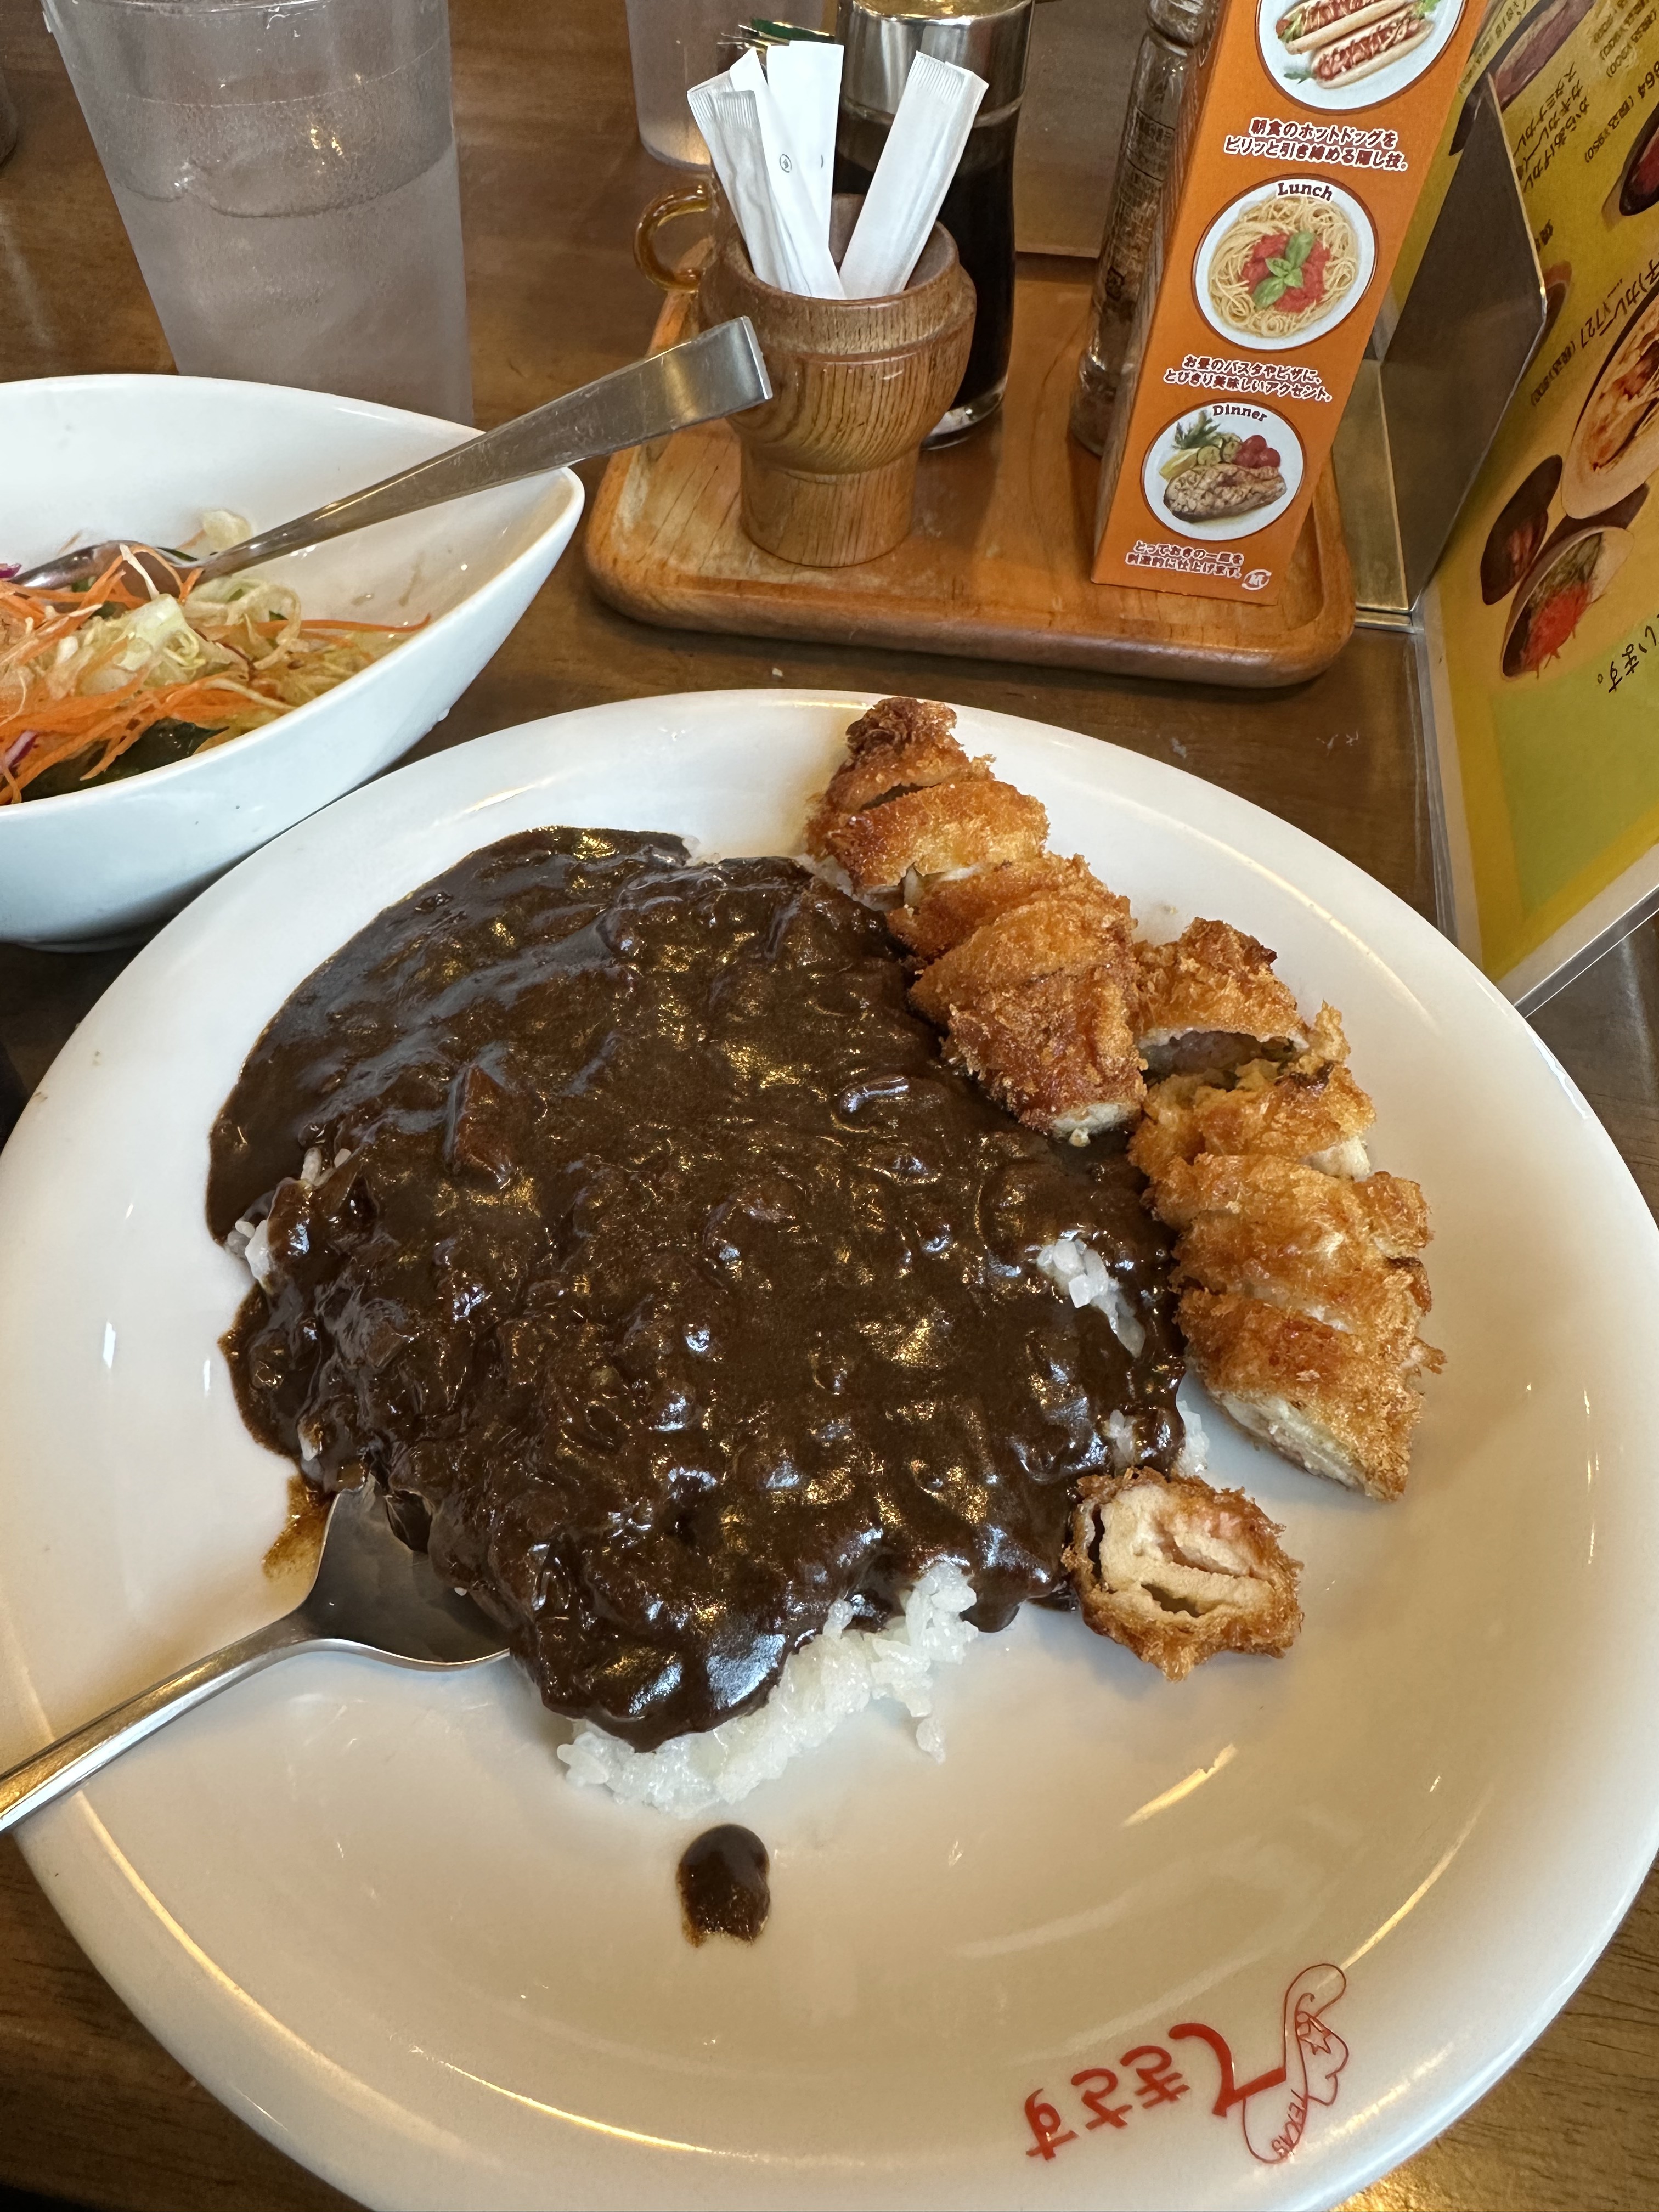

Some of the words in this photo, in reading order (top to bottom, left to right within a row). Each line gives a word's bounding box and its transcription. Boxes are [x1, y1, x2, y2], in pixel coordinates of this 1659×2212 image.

[1277, 182, 1333, 201] Lunch
[1212, 404, 1268, 422] Dinner
[1025, 2022, 1287, 2161] てきさす
